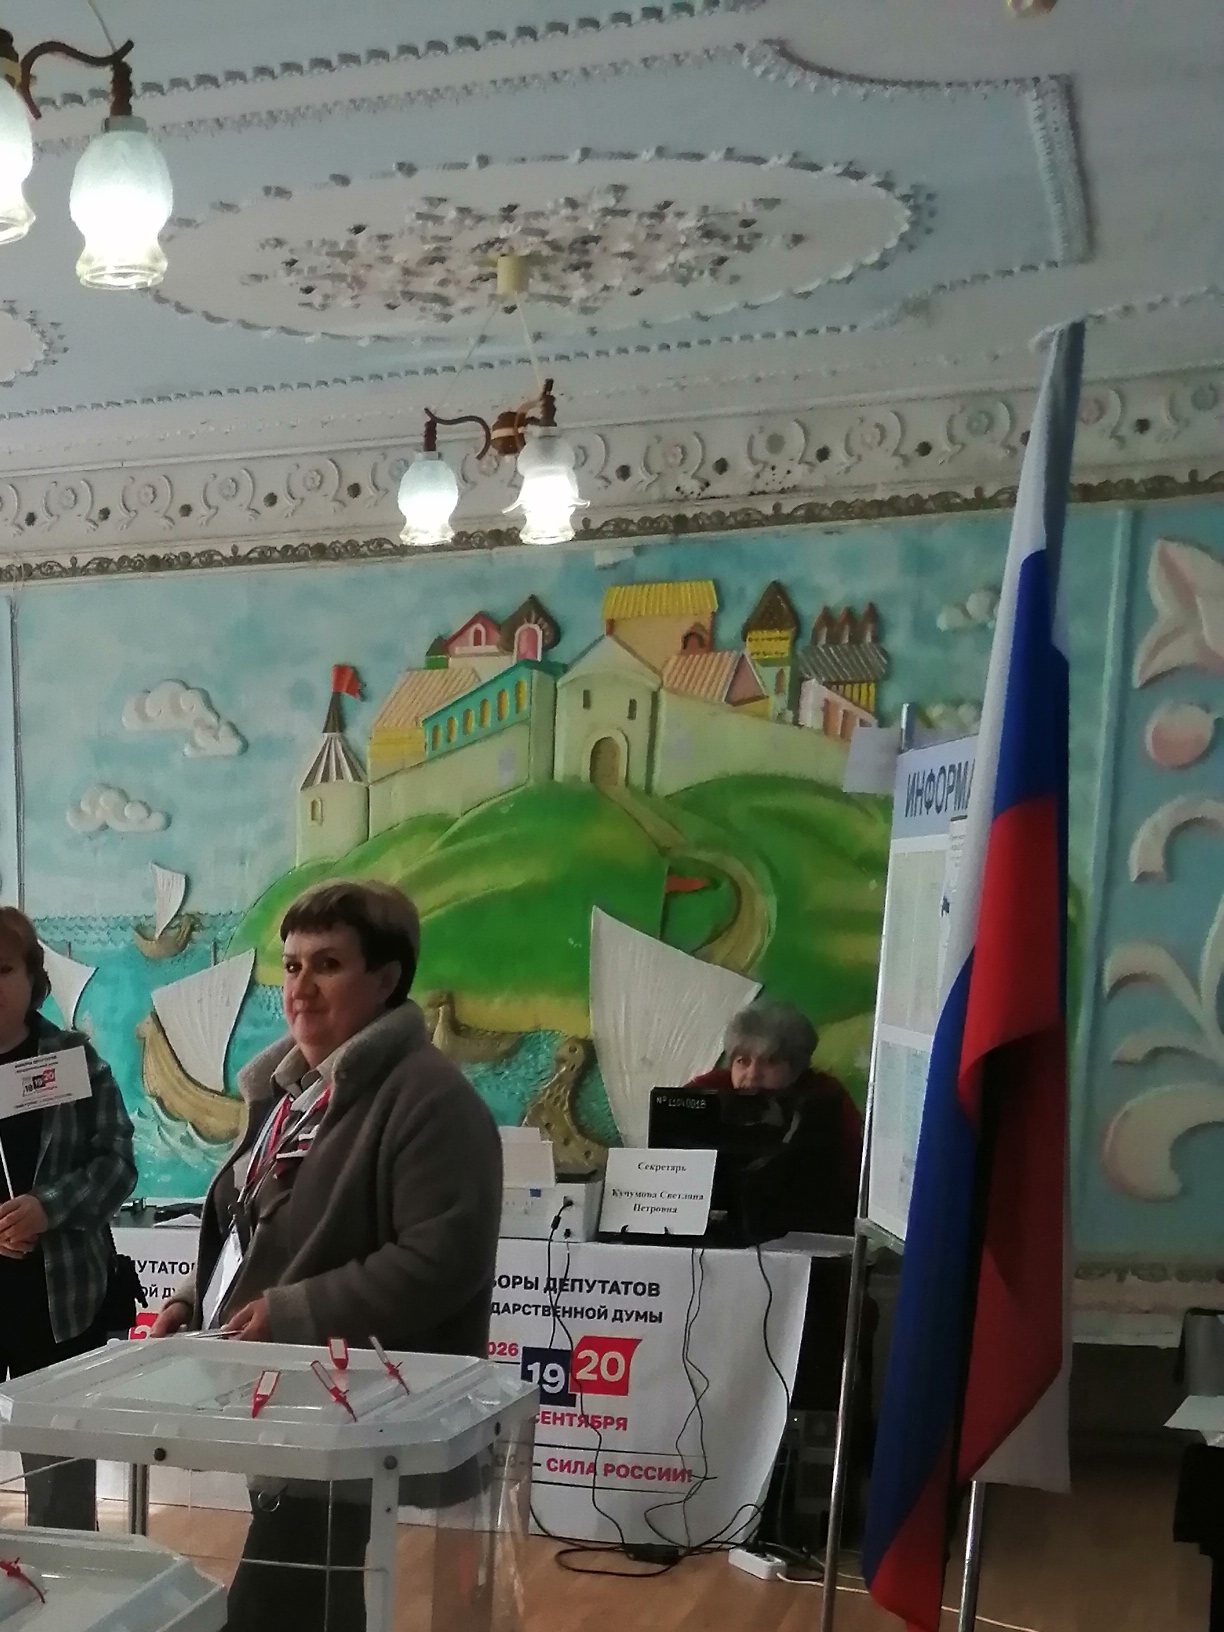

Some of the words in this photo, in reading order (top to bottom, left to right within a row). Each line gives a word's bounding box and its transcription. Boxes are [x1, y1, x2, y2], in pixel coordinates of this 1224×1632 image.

[637, 1161, 686, 1174] Секретарь
[543, 1277, 661, 1298] ДЕПУТАТОВ
[491, 1301, 608, 1321] ДАРСТВЕННОЙ
[611, 1309, 664, 1324] ДУМЫ
[487, 1341, 519, 1357] 026
[527, 1361, 566, 1395] 19
[576, 1349, 626, 1383] 20
[545, 1457, 597, 1475] СИЛА
[603, 1463, 693, 1483] РОССИИ!
